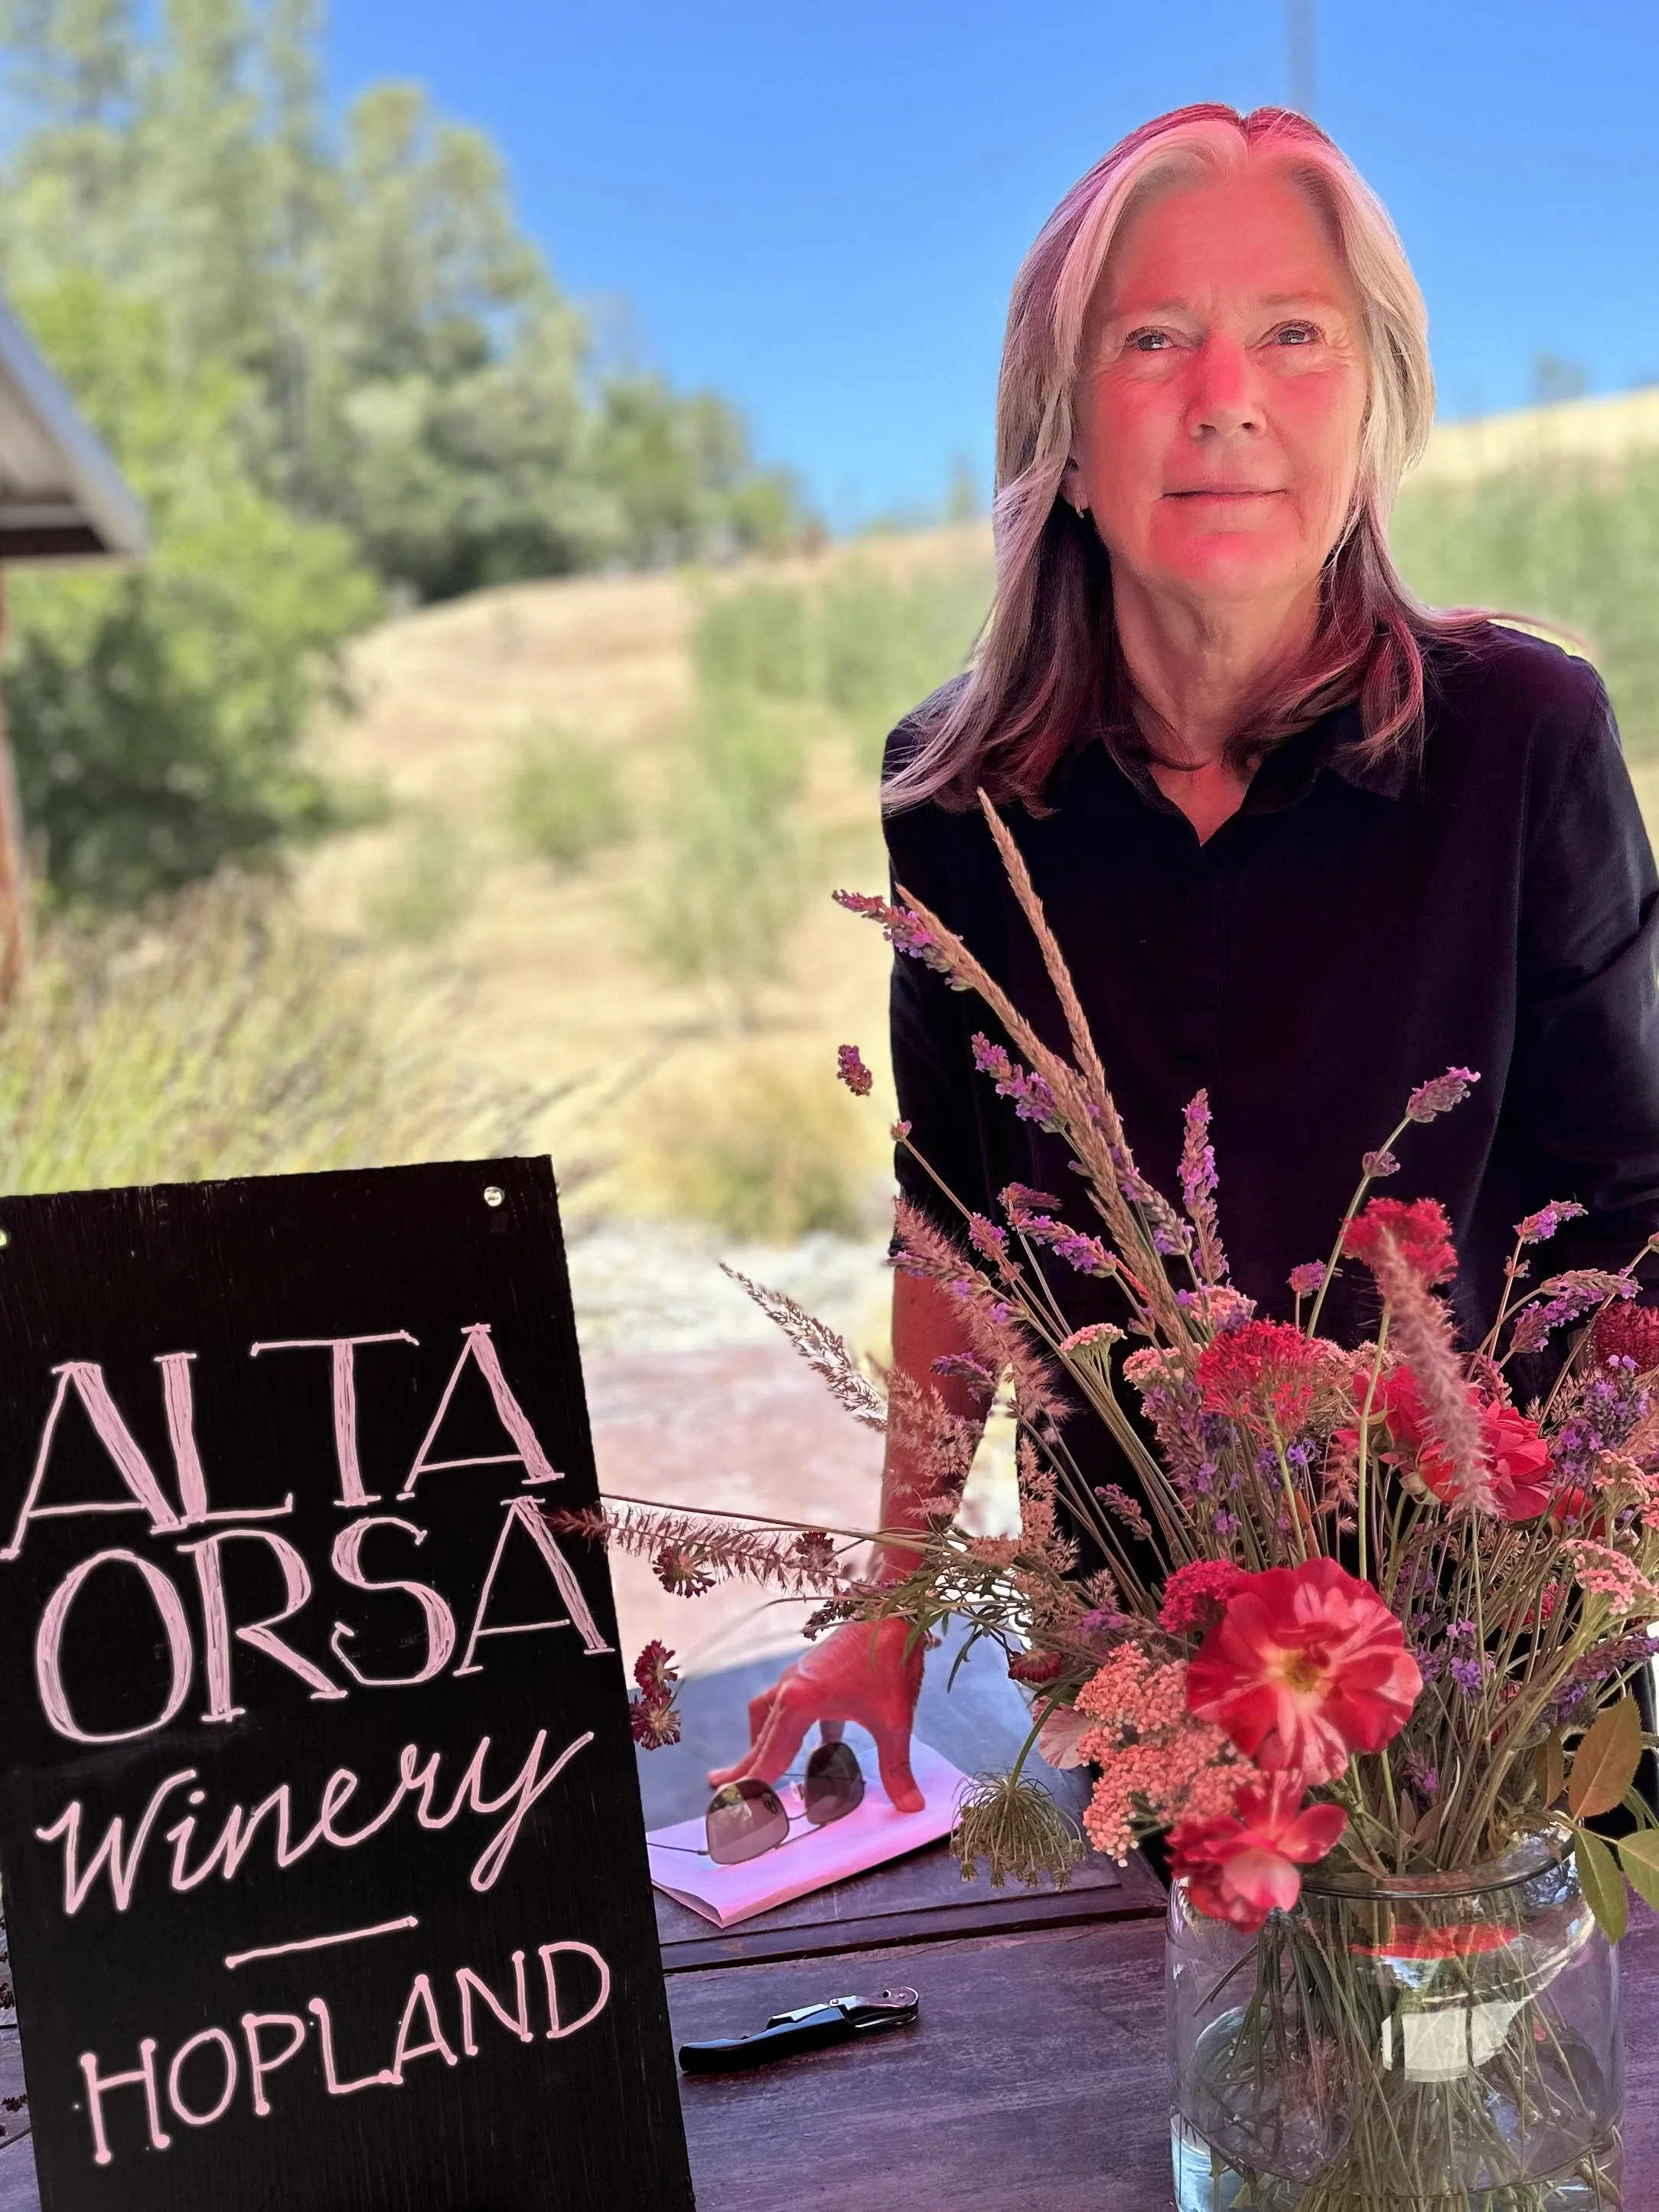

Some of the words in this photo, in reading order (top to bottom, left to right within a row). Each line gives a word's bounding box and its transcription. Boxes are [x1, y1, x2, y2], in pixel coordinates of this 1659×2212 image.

[0, 1323, 565, 1559] ALTA
[35, 1495, 615, 1743] ORSA
[35, 1729, 595, 1915] Winery
[79, 1940, 611, 2165] HOPLAND
